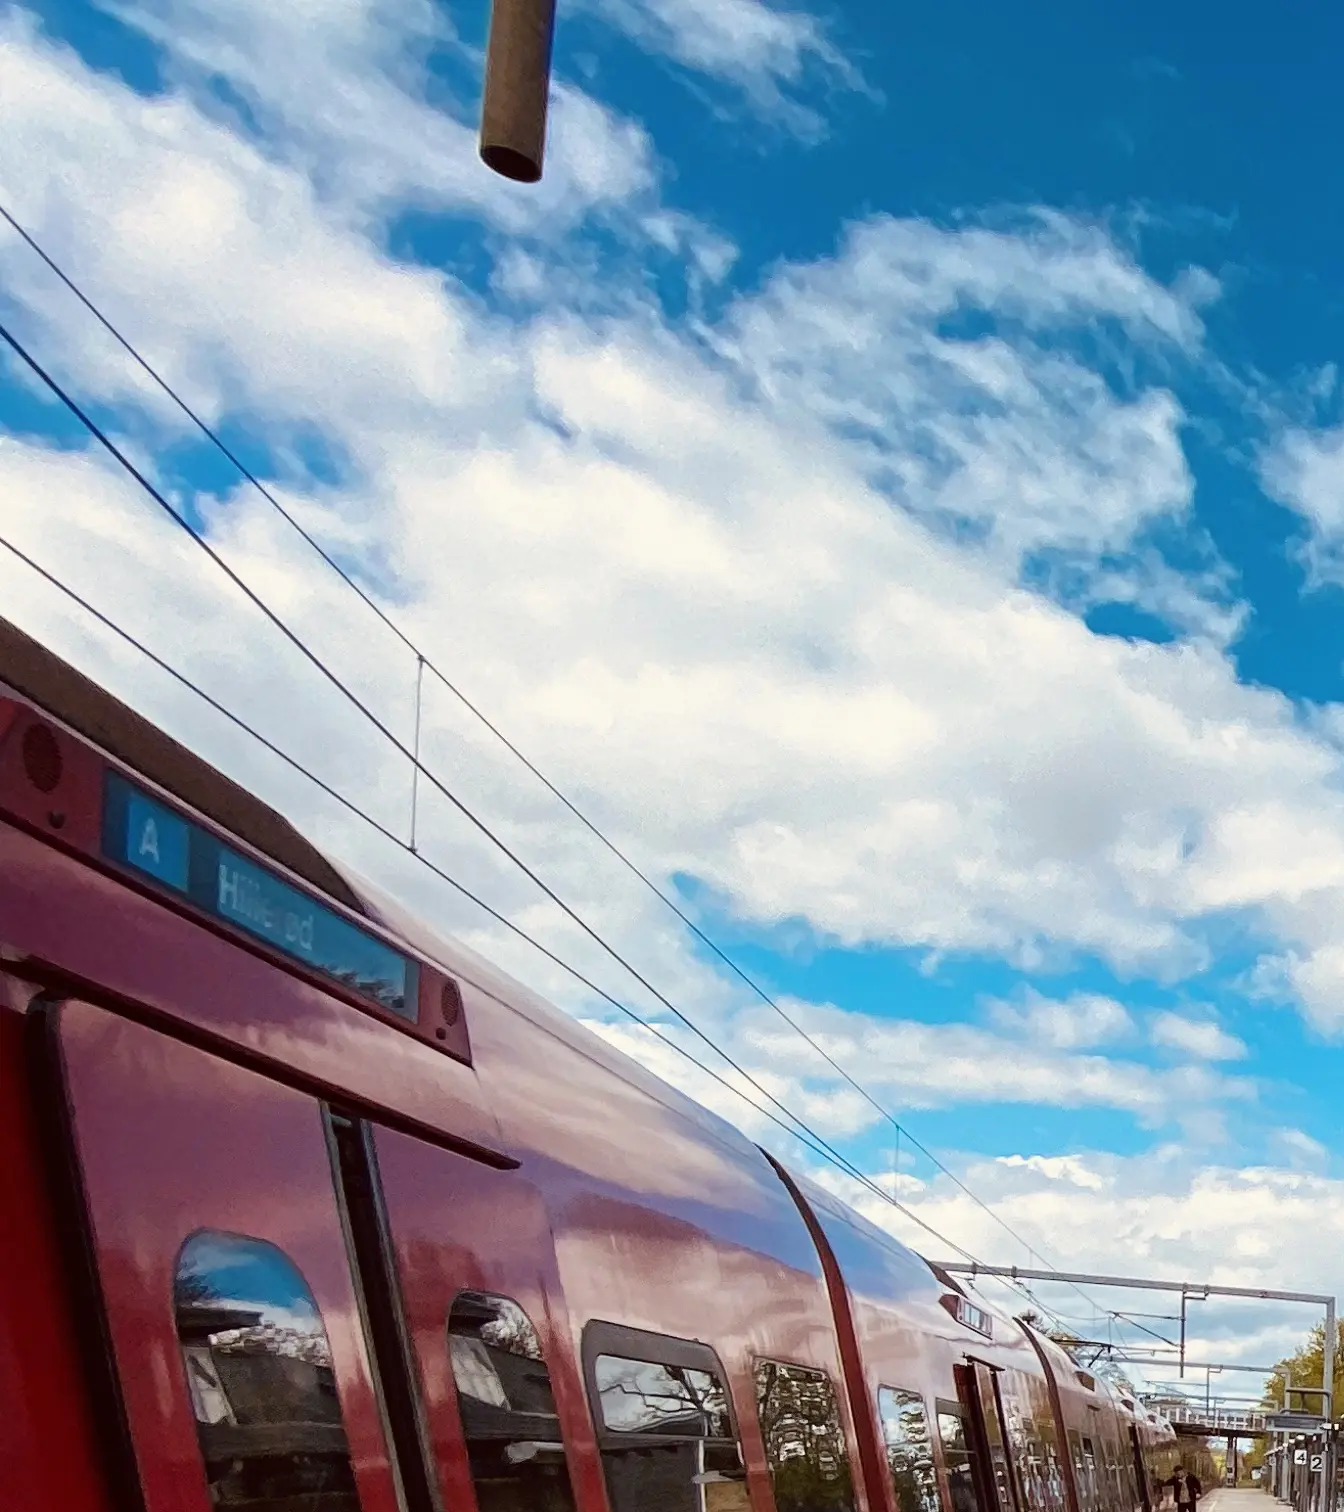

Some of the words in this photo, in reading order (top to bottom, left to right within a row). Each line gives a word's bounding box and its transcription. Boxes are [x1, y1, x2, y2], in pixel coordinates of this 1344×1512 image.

[139, 817, 160, 864] A
[1296, 1452, 1306, 1464] 4
[1312, 1456, 1323, 1470] 2
